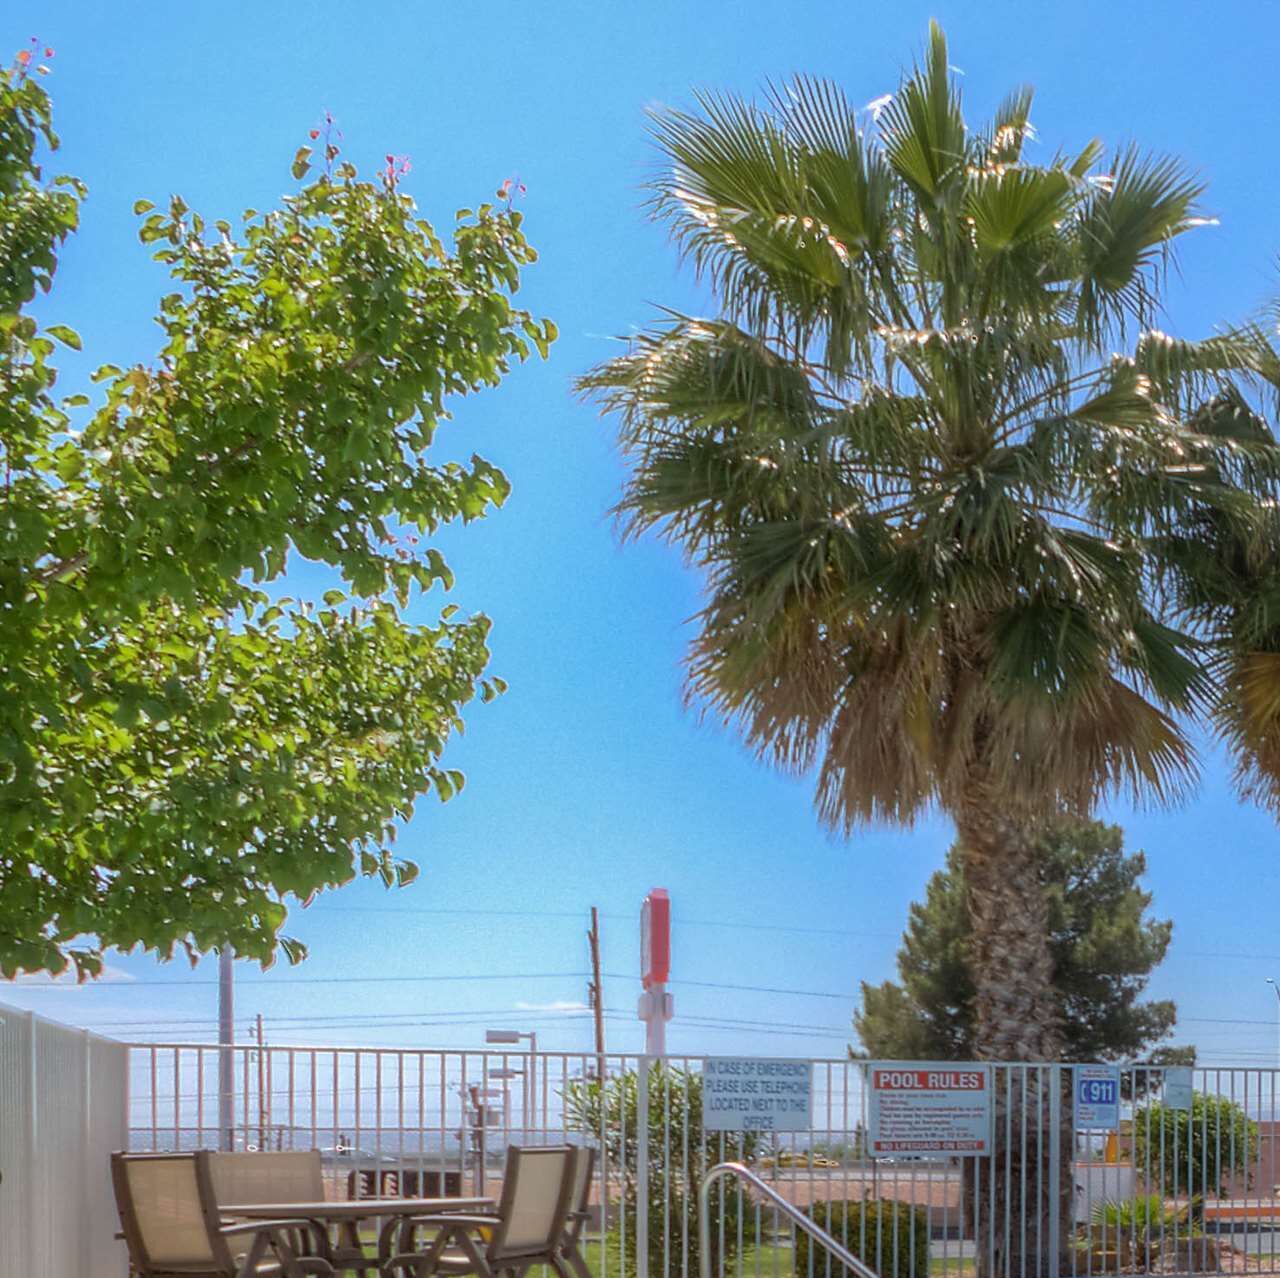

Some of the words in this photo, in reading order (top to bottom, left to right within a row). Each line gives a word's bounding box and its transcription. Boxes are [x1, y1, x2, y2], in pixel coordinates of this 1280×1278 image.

[718, 1062, 741, 1075] CASE
[744, 1062, 756, 1075] OF
[706, 1080, 740, 1094] PLEASE
[741, 1080, 759, 1094] USE
[761, 1080, 810, 1095] TELEPHONE
[879, 1072, 923, 1088] POOL
[928, 1073, 979, 1089] RULES
[1091, 1082, 1112, 1101] 911
[710, 1097, 749, 1111] LOCATED
[752, 1097, 774, 1111] NEXT
[776, 1098, 788, 1112] TO
[790, 1098, 807, 1112] THE
[743, 1115, 774, 1130] OFFICE
[880, 1141, 893, 1150] NO
[895, 1141, 941, 1151] LIFEGUARD
